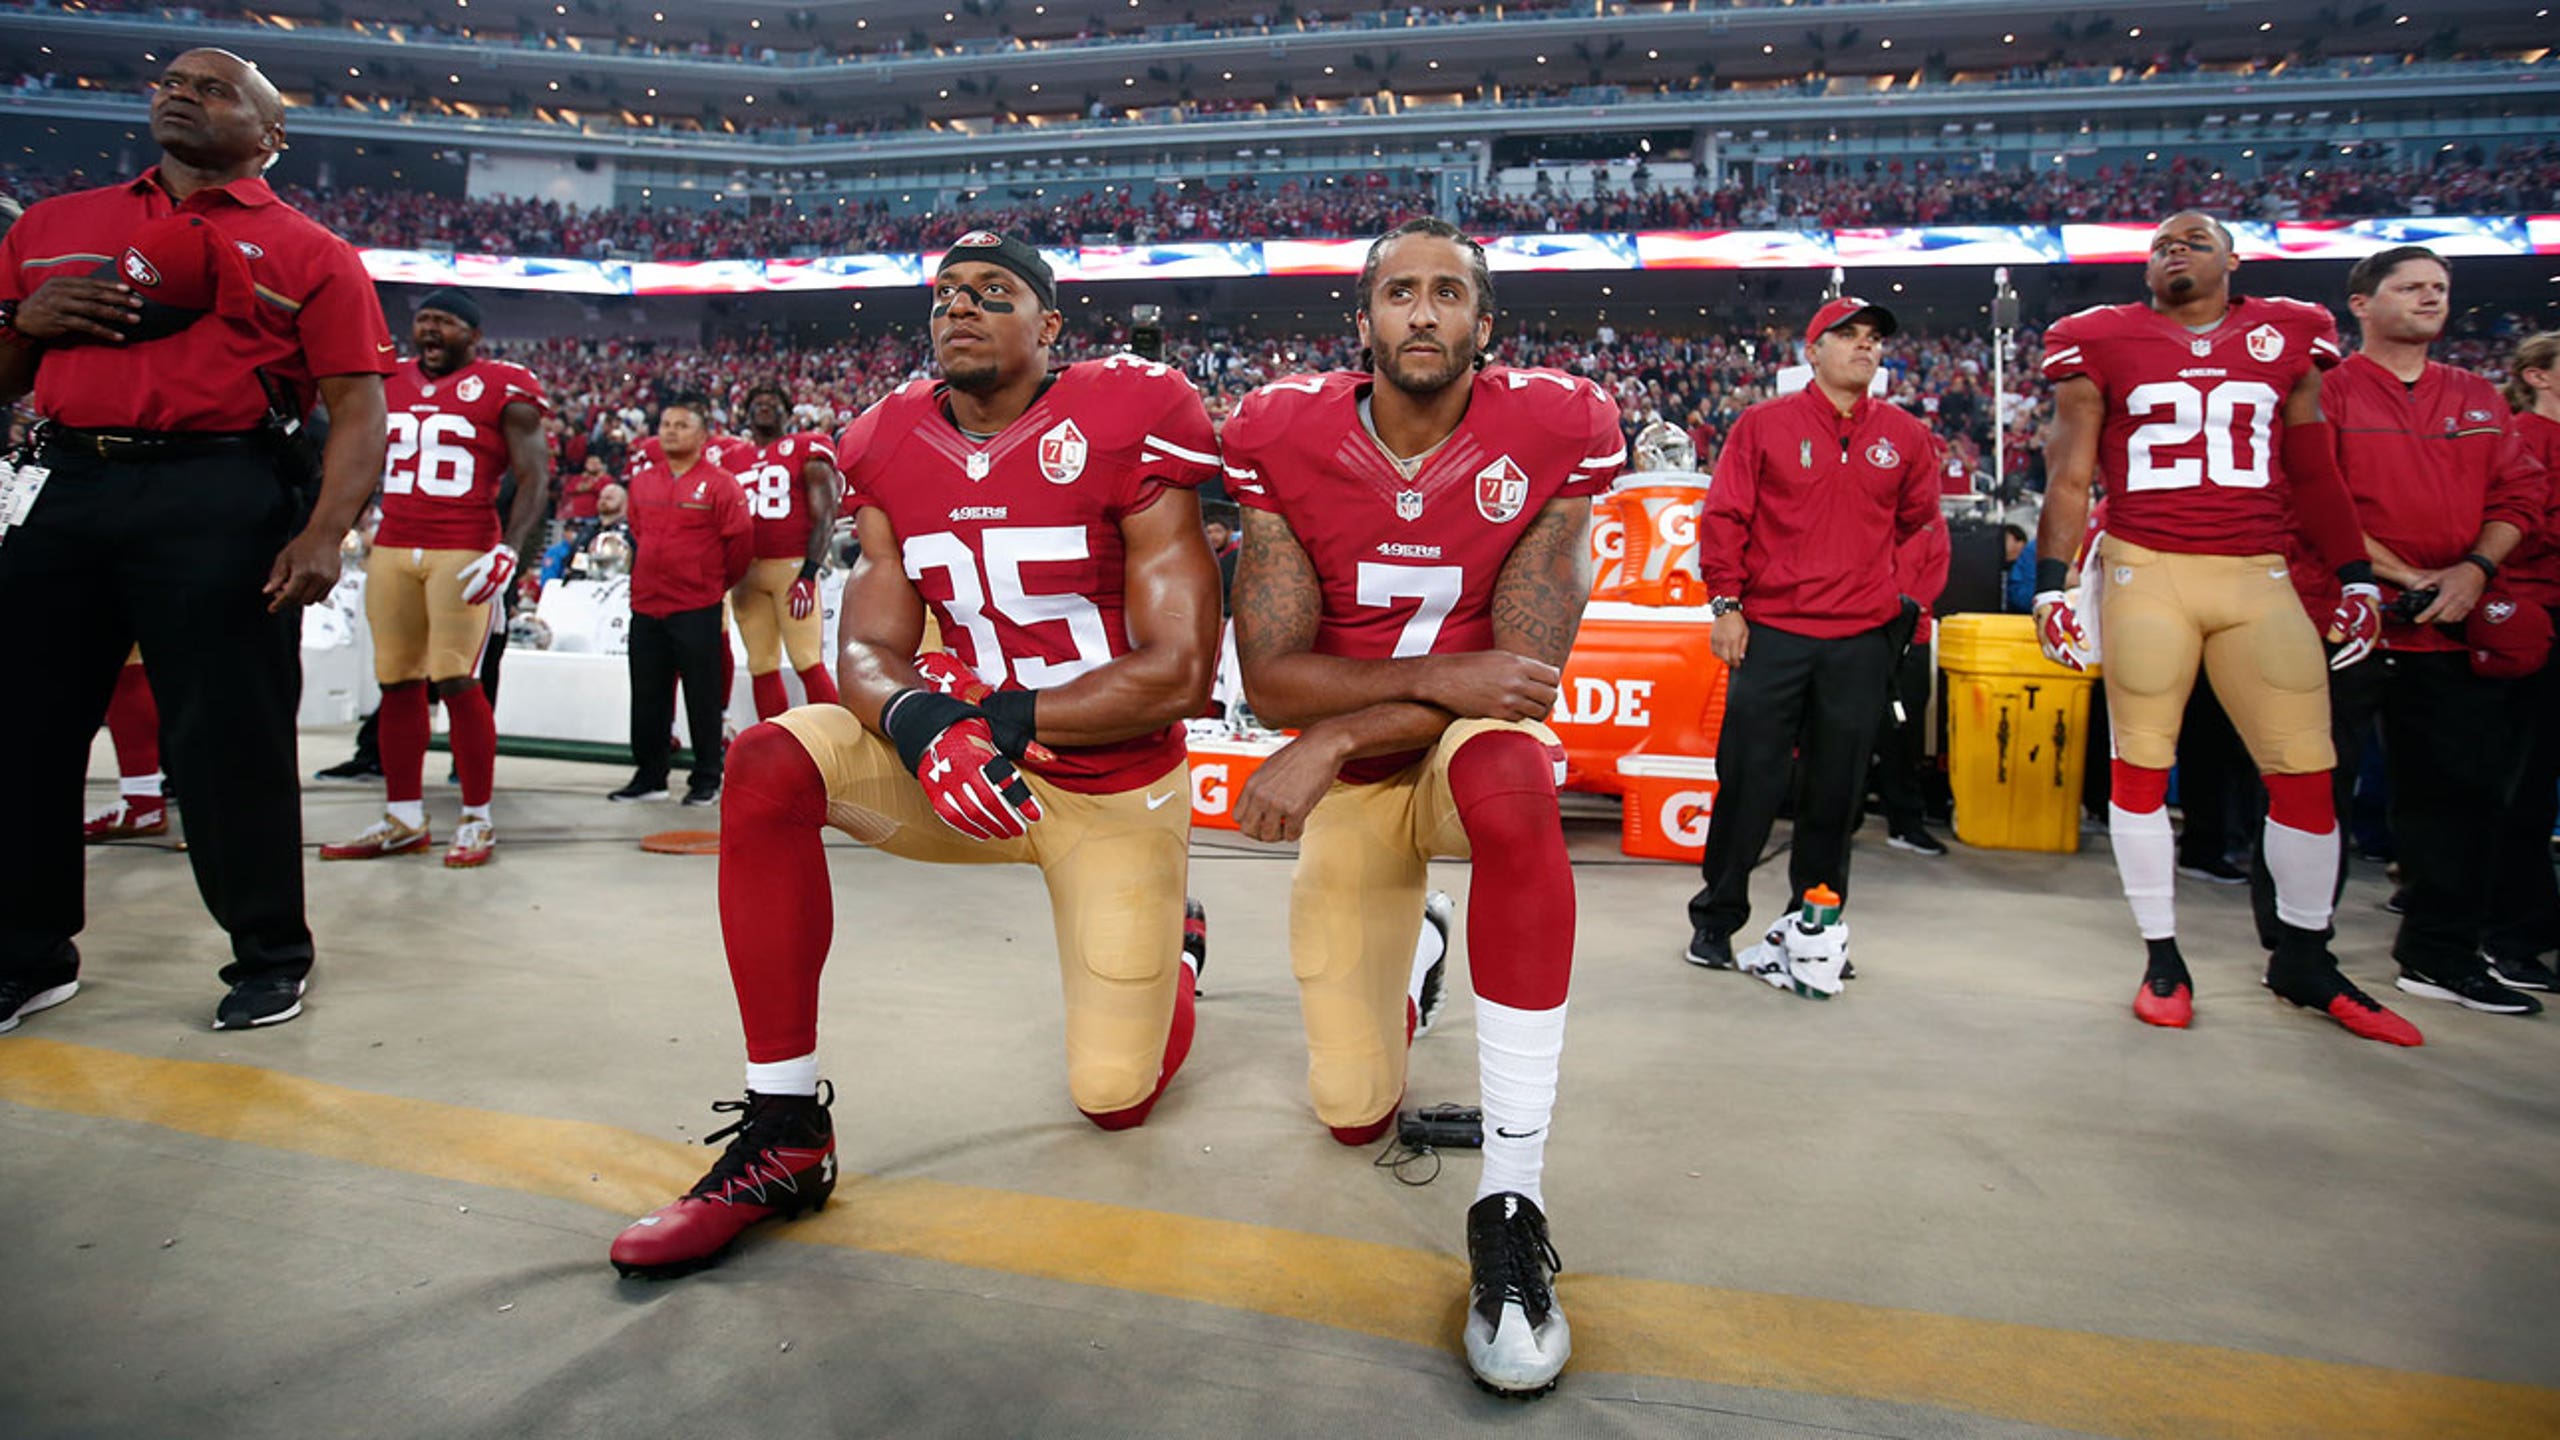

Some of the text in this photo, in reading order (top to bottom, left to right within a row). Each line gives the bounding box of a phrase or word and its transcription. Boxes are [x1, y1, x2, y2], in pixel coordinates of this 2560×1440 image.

[383, 412, 476, 497] 26
[2126, 380, 2279, 492] 20
[735, 465, 791, 519] 58
[948, 506, 1008, 521] 49ERS
[1487, 482, 1517, 502] 70
[1376, 542, 1442, 559] 49ERS
[1594, 521, 1625, 559] G
[1658, 504, 1697, 546] G
[902, 525, 1113, 692] 35
[1356, 561, 1463, 659] 7
[1190, 763, 1228, 815] G
[1660, 791, 1713, 847] G
